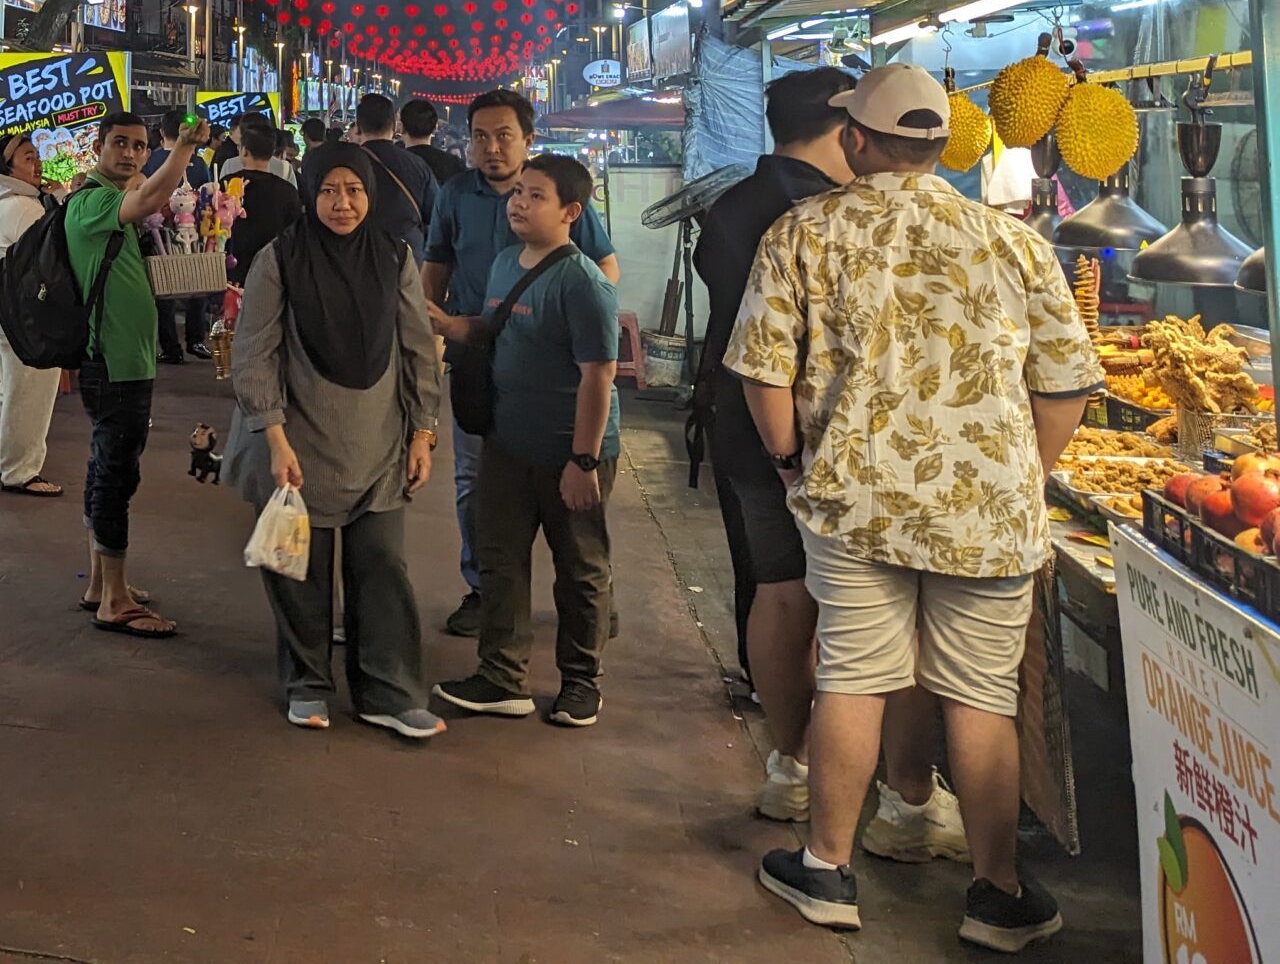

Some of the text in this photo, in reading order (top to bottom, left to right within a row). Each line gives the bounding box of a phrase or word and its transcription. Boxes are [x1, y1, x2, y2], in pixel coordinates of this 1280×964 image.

[7, 57, 73, 101] BEST
[79, 79, 115, 106] POT
[7, 117, 50, 137] MALAYSIA
[57, 105, 99, 124] MUST TRY
[207, 95, 247, 121] BEST
[1126, 562, 1260, 700] PURE AND FRESH
[1166, 639, 1222, 707] HONEY
[1141, 651, 1280, 824] ORANGE JUICE
[1172, 739, 1259, 866] 新鲜橙汁
[1173, 900, 1198, 944] RM
